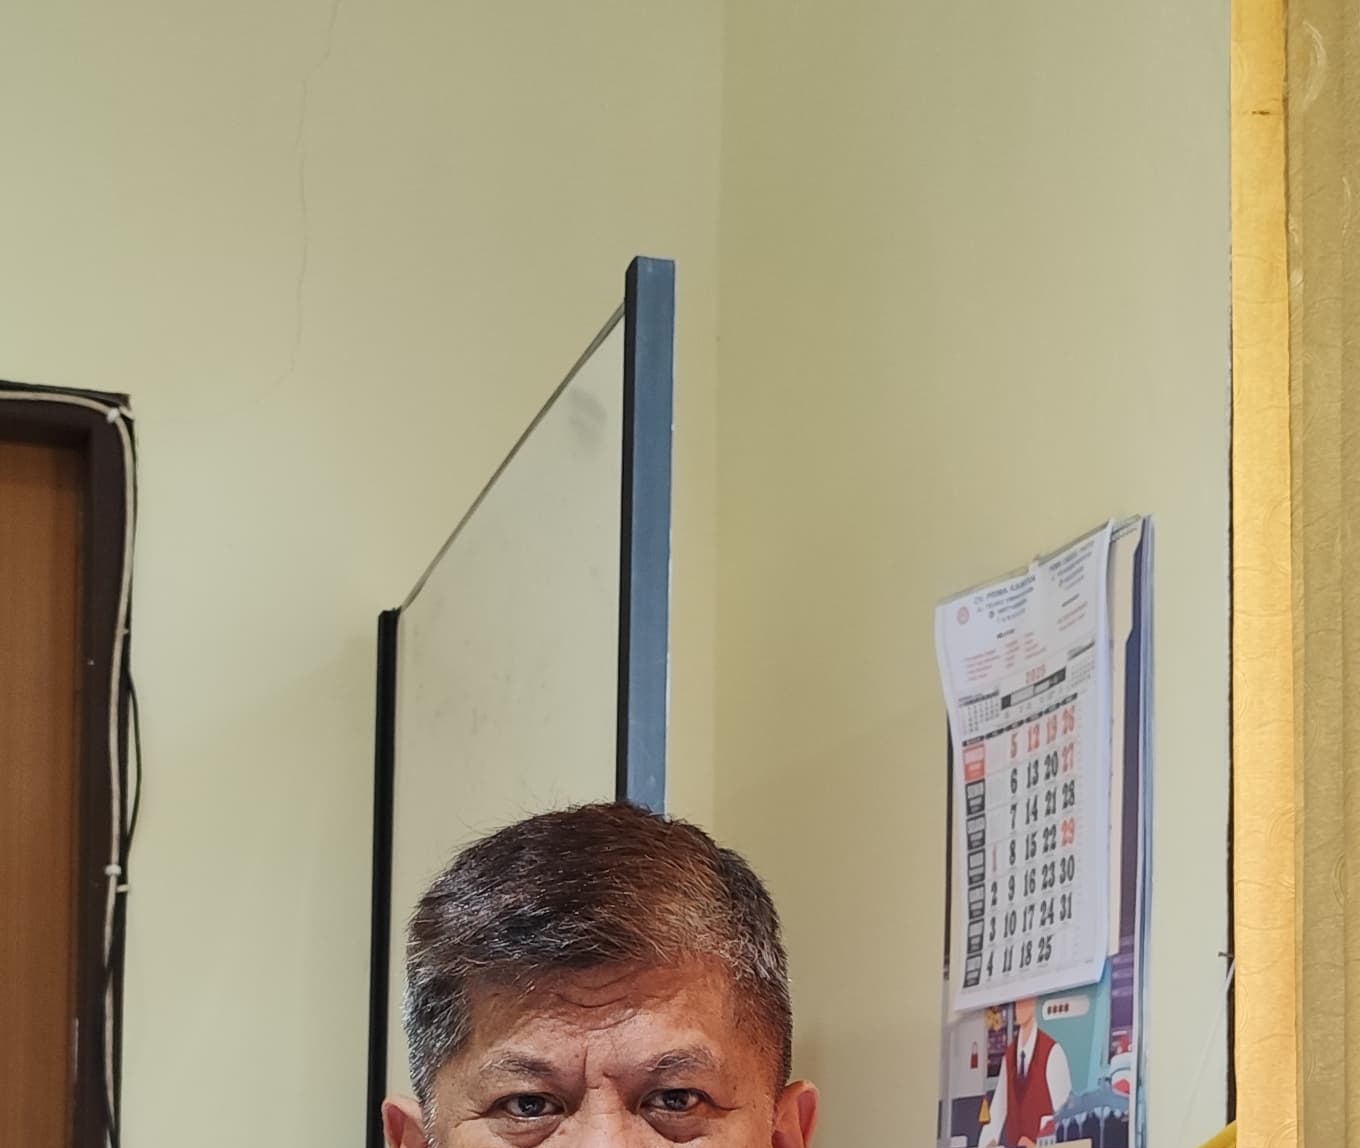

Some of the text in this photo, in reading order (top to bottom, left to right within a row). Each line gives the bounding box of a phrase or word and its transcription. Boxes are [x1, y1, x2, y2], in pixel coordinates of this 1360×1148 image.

[1009, 733, 1018, 760] 5
[1027, 723, 1040, 753] 12
[1010, 743, 1075, 794] 6 13 20 27
[1009, 780, 1075, 830] 7 14 21 28
[1008, 839, 1017, 866] 8
[1024, 832, 1037, 860] 15
[1043, 824, 1057, 851] 22
[990, 855, 1075, 906] 2 9 16 23 30
[988, 892, 1073, 943] 3 10 17 24 31
[986, 935, 1053, 977] 4 11 18 25
